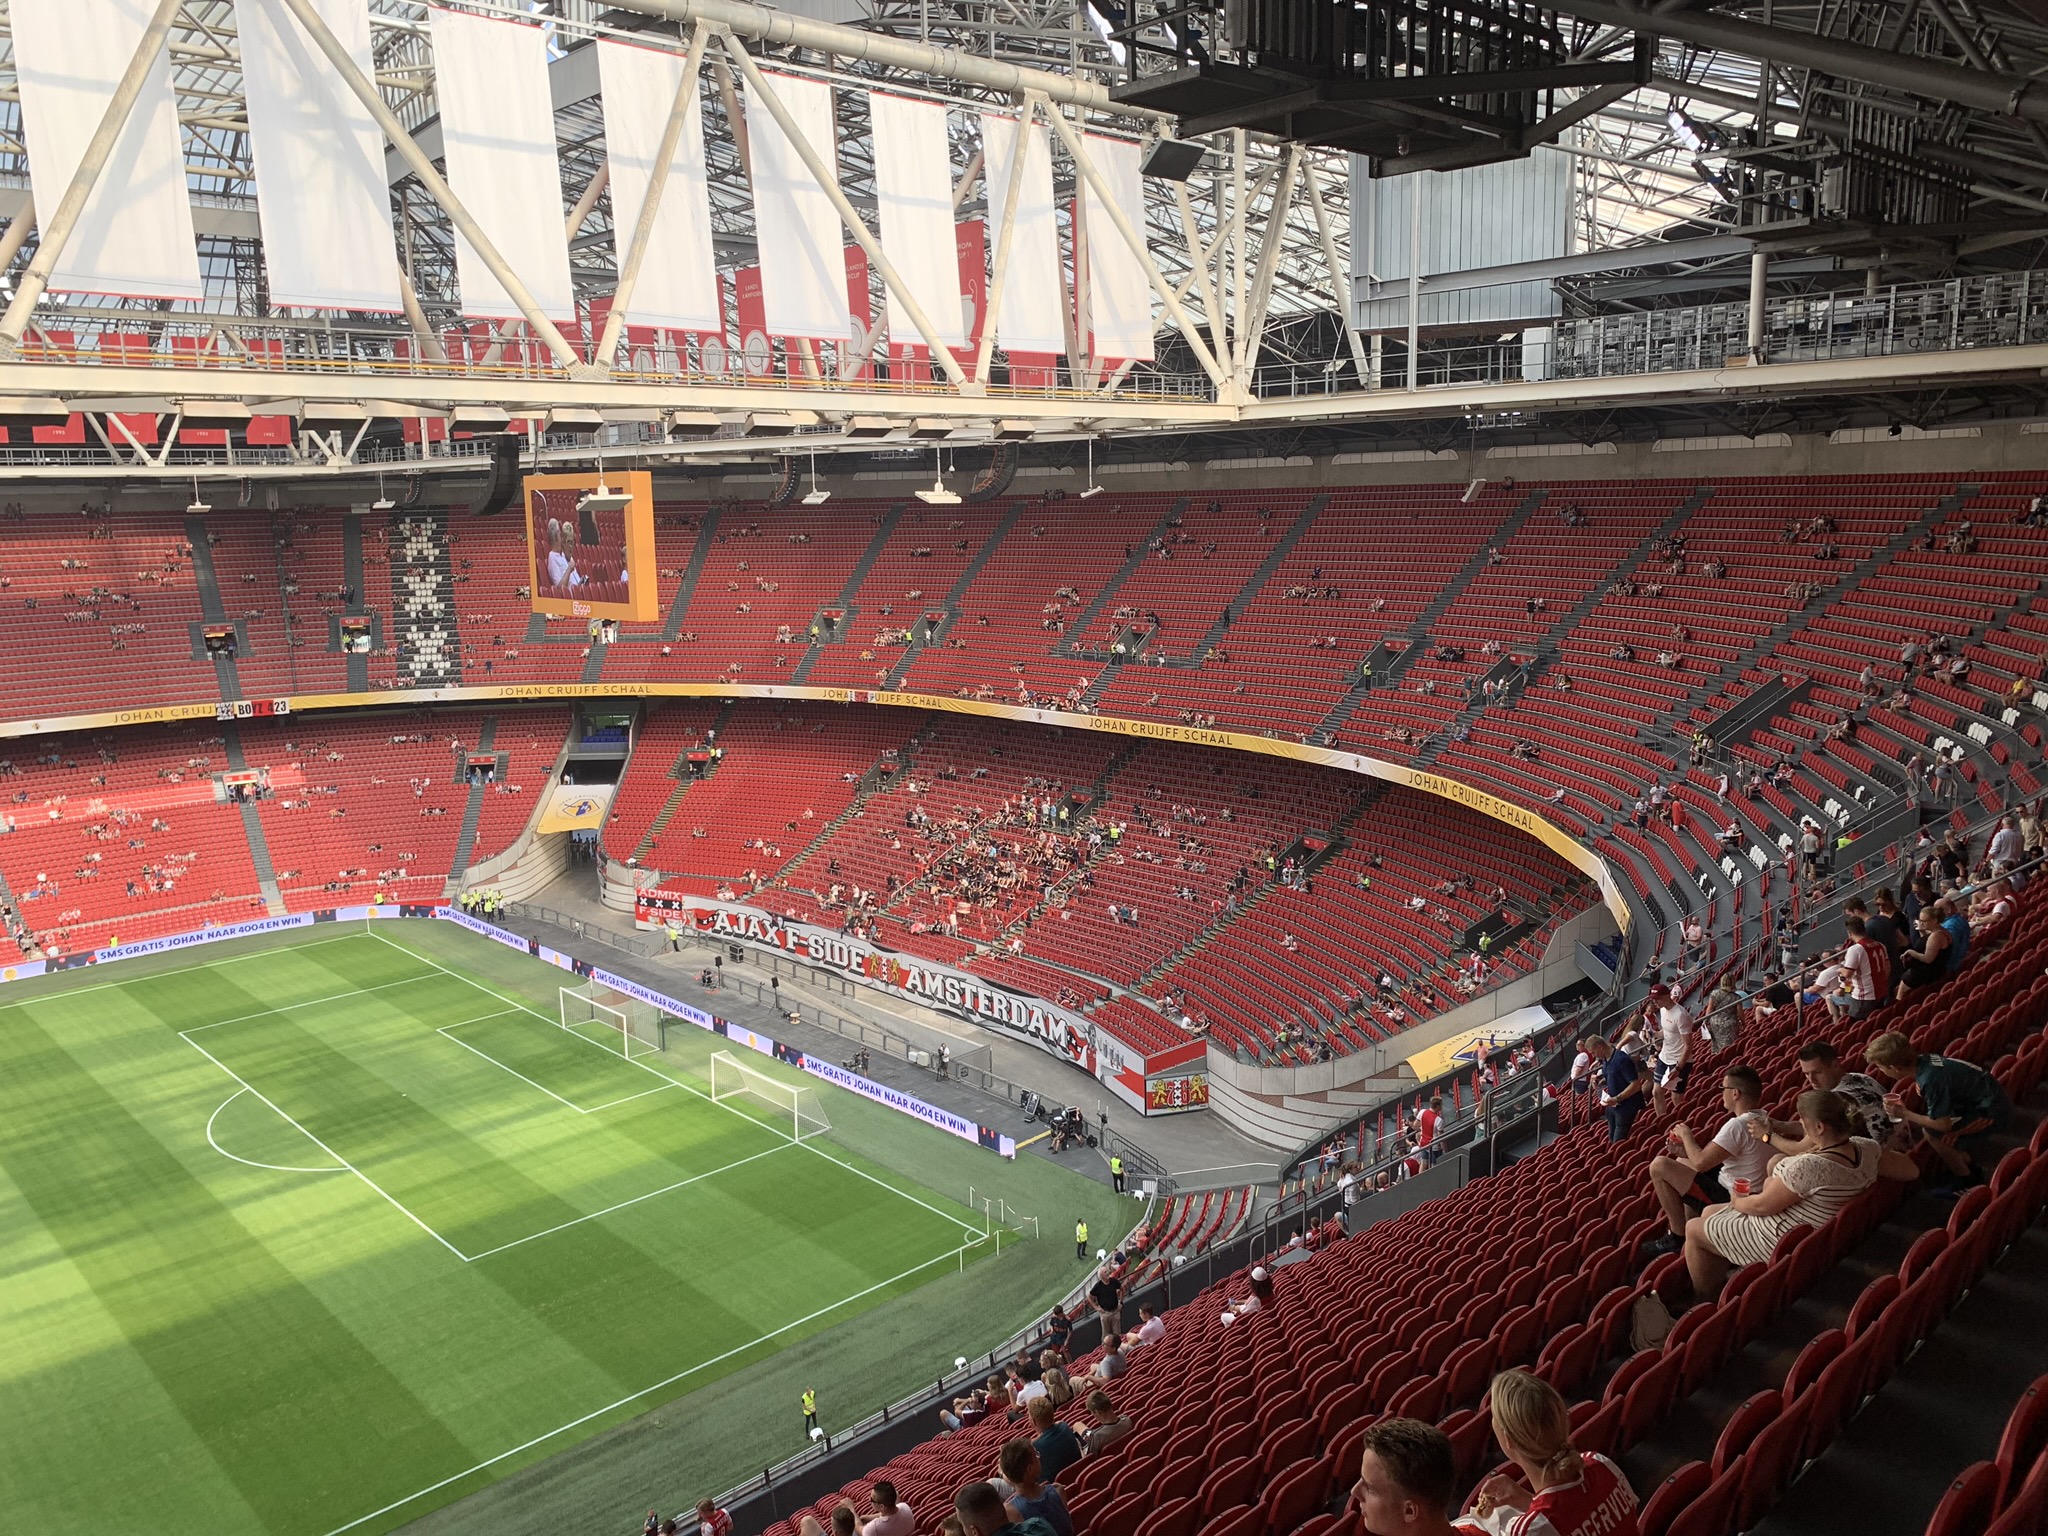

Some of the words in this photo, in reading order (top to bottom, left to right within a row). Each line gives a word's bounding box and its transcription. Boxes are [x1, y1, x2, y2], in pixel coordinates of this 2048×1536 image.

[572, 601, 592, 616] Ziggo
[498, 686, 543, 697] JOHAN
[547, 685, 598, 695] CRUIJFF
[603, 684, 651, 694] SCHAAL
[822, 689, 848, 699] JOHA
[874, 693, 902, 703] UIJFF
[905, 695, 942, 708] SCHAAL
[113, 709, 164, 724] JOHAN
[171, 705, 213, 717] CRUIJ
[238, 703, 263, 716] BOYZ
[1089, 718, 1127, 732] JOHAN
[1131, 722, 1179, 738] CRUIJFF
[1184, 730, 1233, 746] SCHAAL
[1408, 771, 1448, 794] JOHAN
[1451, 784, 1490, 810] CRUIJFF
[1493, 801, 1534, 831] SCHAAL
[638, 888, 681, 901] ADMIX
[639, 906, 681, 920] F-SIDE
[100, 948, 124, 960] SMS
[125, 940, 165, 956] GRATIS
[207, 927, 236, 941] NAAR
[238, 922, 265, 935] 4004
[266, 919, 280, 930] EN
[280, 916, 302, 927] WIN
[713, 909, 785, 948] AJAX
[786, 925, 865, 975] F-SIDE
[904, 963, 1069, 1051] AMSTERDAM
[596, 971, 608, 982] SMS
[608, 975, 629, 991] GRATIS
[650, 994, 667, 1008] NAAR
[667, 1001, 684, 1015] 4004
[684, 1008, 692, 1018] EN
[692, 1011, 706, 1024] WIN
[806, 1058, 823, 1073] SMS
[823, 1066, 851, 1085] GRATIS
[884, 1090, 909, 1109] NAAR
[909, 1101, 933, 1120] 4004
[934, 1110, 947, 1124] EN
[947, 1116, 967, 1134] WIN
